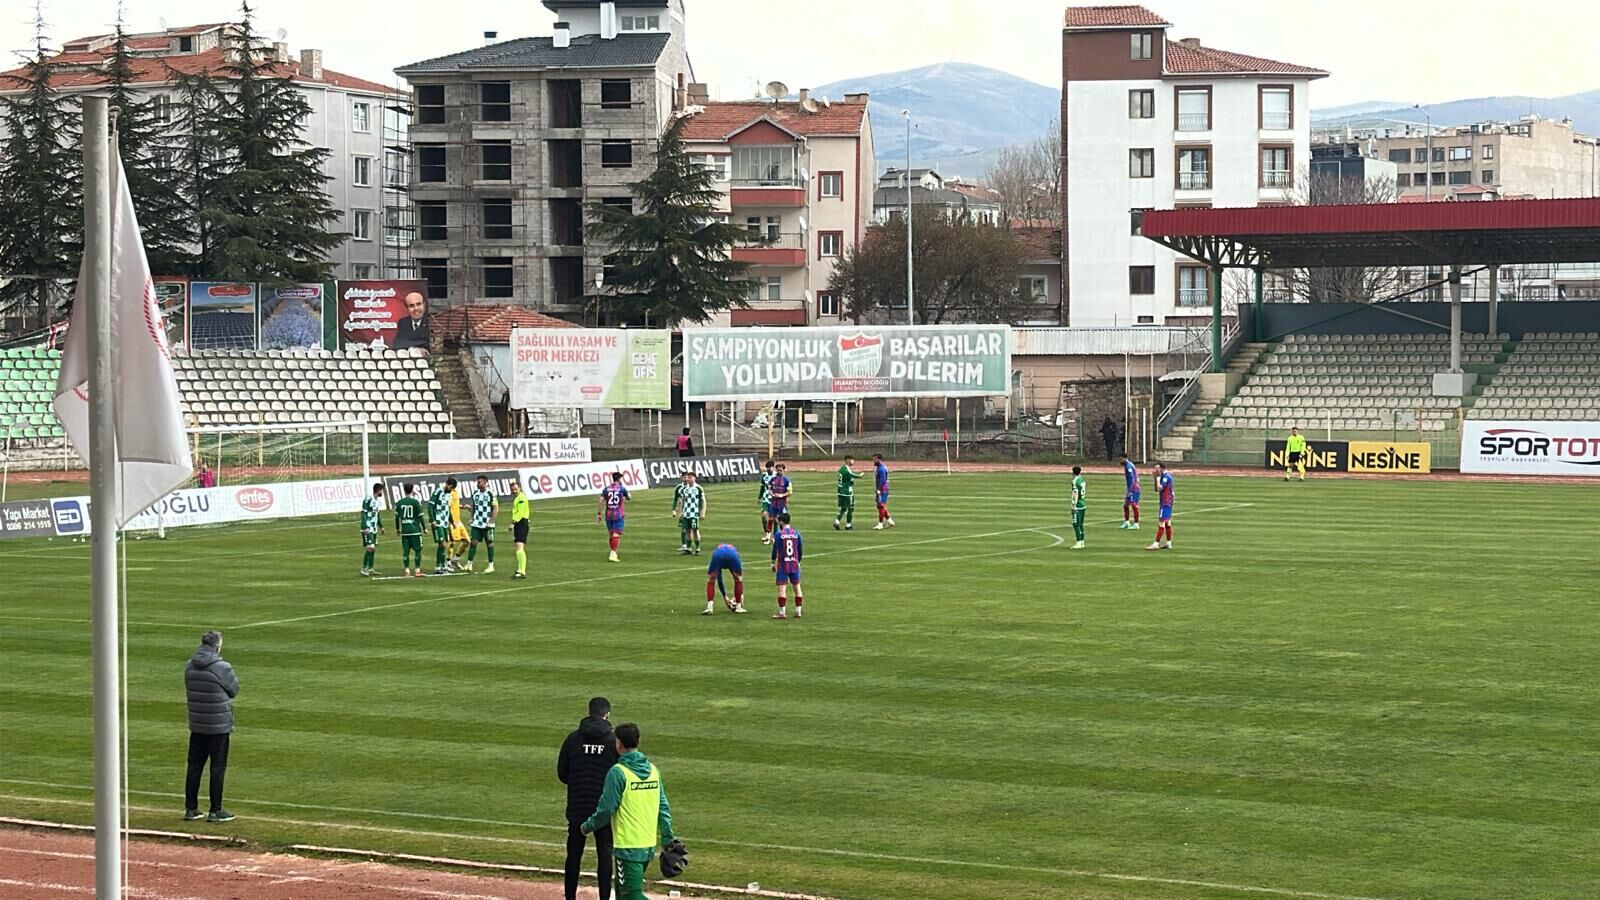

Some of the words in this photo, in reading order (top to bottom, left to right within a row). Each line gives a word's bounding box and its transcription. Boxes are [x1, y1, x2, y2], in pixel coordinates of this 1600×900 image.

[518, 333, 564, 347] SAĞLIKLI
[566, 335, 602, 349] YAŞAM
[604, 336, 617, 348] VE
[691, 337, 833, 364] ŞAMPİYONLUK
[890, 333, 1002, 359] BAŞARILAR
[518, 350, 548, 362] SPOR
[551, 350, 599, 362] MERKEZİ
[721, 362, 833, 388] YOLUNDA
[890, 361, 983, 386] DİLERİM
[477, 442, 550, 460] KEYMEN
[560, 441, 578, 451] İLAÇ
[1270, 445, 1337, 468] NİNE
[1351, 447, 1420, 469] NESİNE
[716, 457, 759, 476] METAL
[392, 481, 435, 503] BİSÖZ
[608, 491, 619, 505] 25
[3, 508, 21, 522] Yapı
[22, 506, 50, 519] Market
[401, 505, 413, 518] 70
[786, 540, 794, 556] 8
[583, 744, 604, 754] TFF
